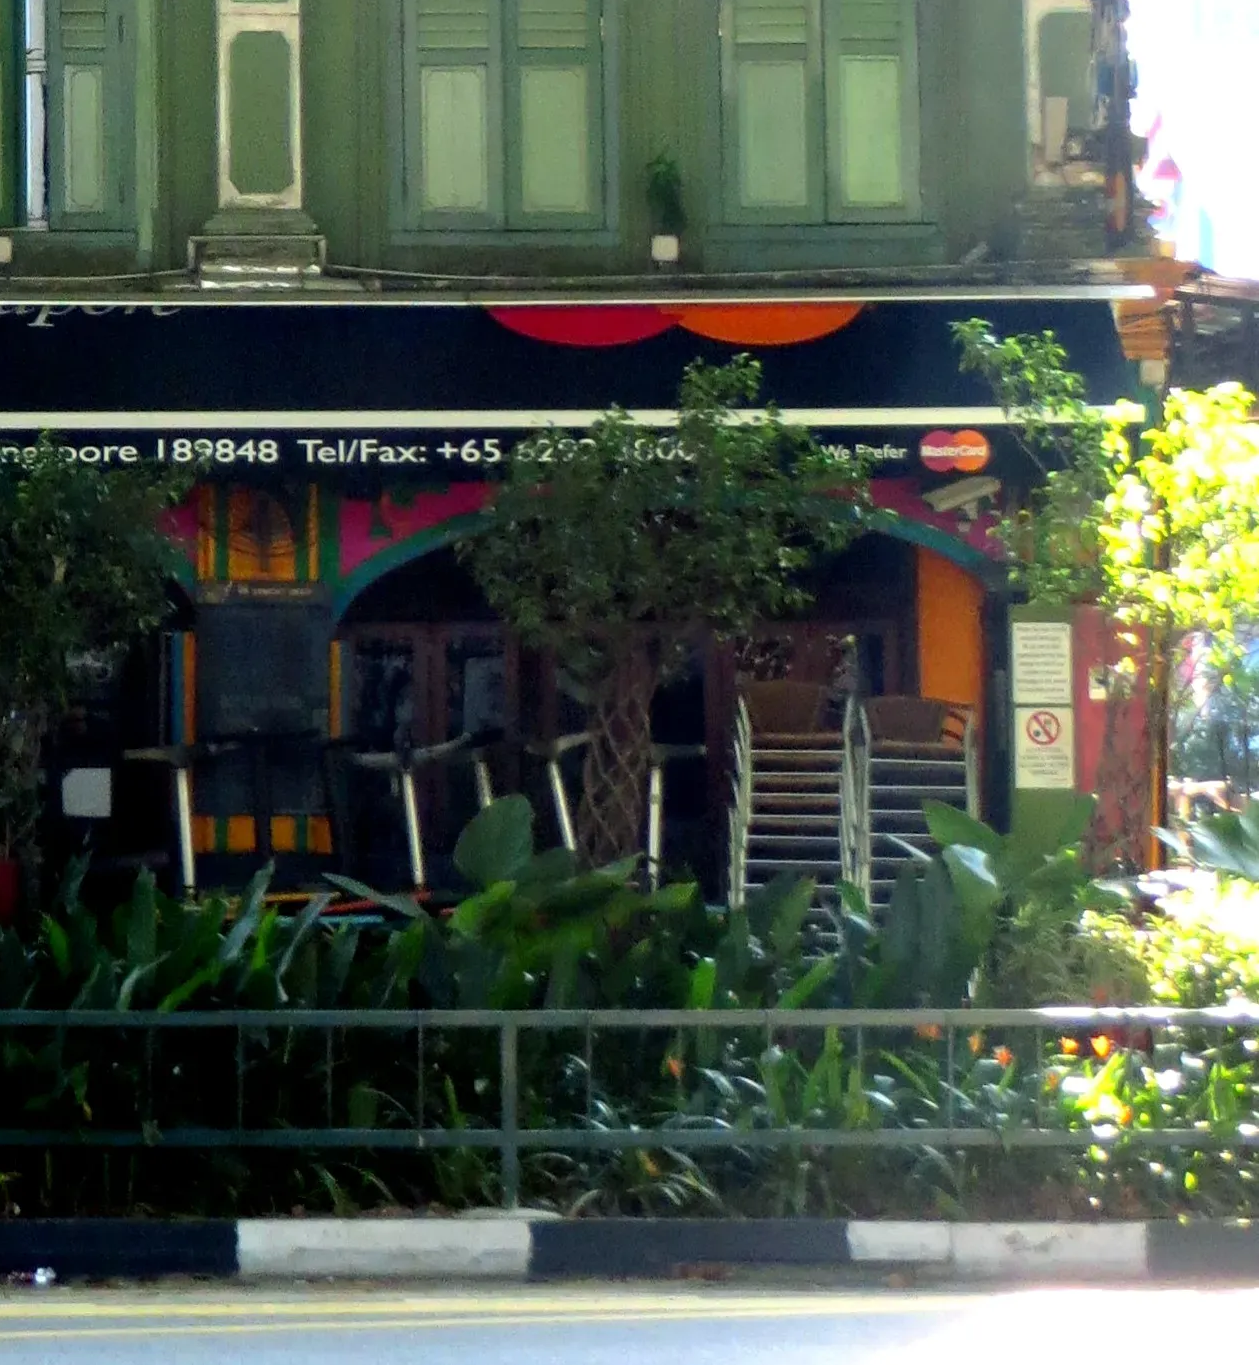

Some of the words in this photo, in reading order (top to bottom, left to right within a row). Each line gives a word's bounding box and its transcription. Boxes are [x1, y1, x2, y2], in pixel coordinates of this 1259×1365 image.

[157, 438, 279, 464] 189848
[296, 438, 427, 464] Tel/Fax:
[436, 438, 502, 463] +65
[820, 444, 850, 460] We
[920, 445, 986, 458] MasterCard
